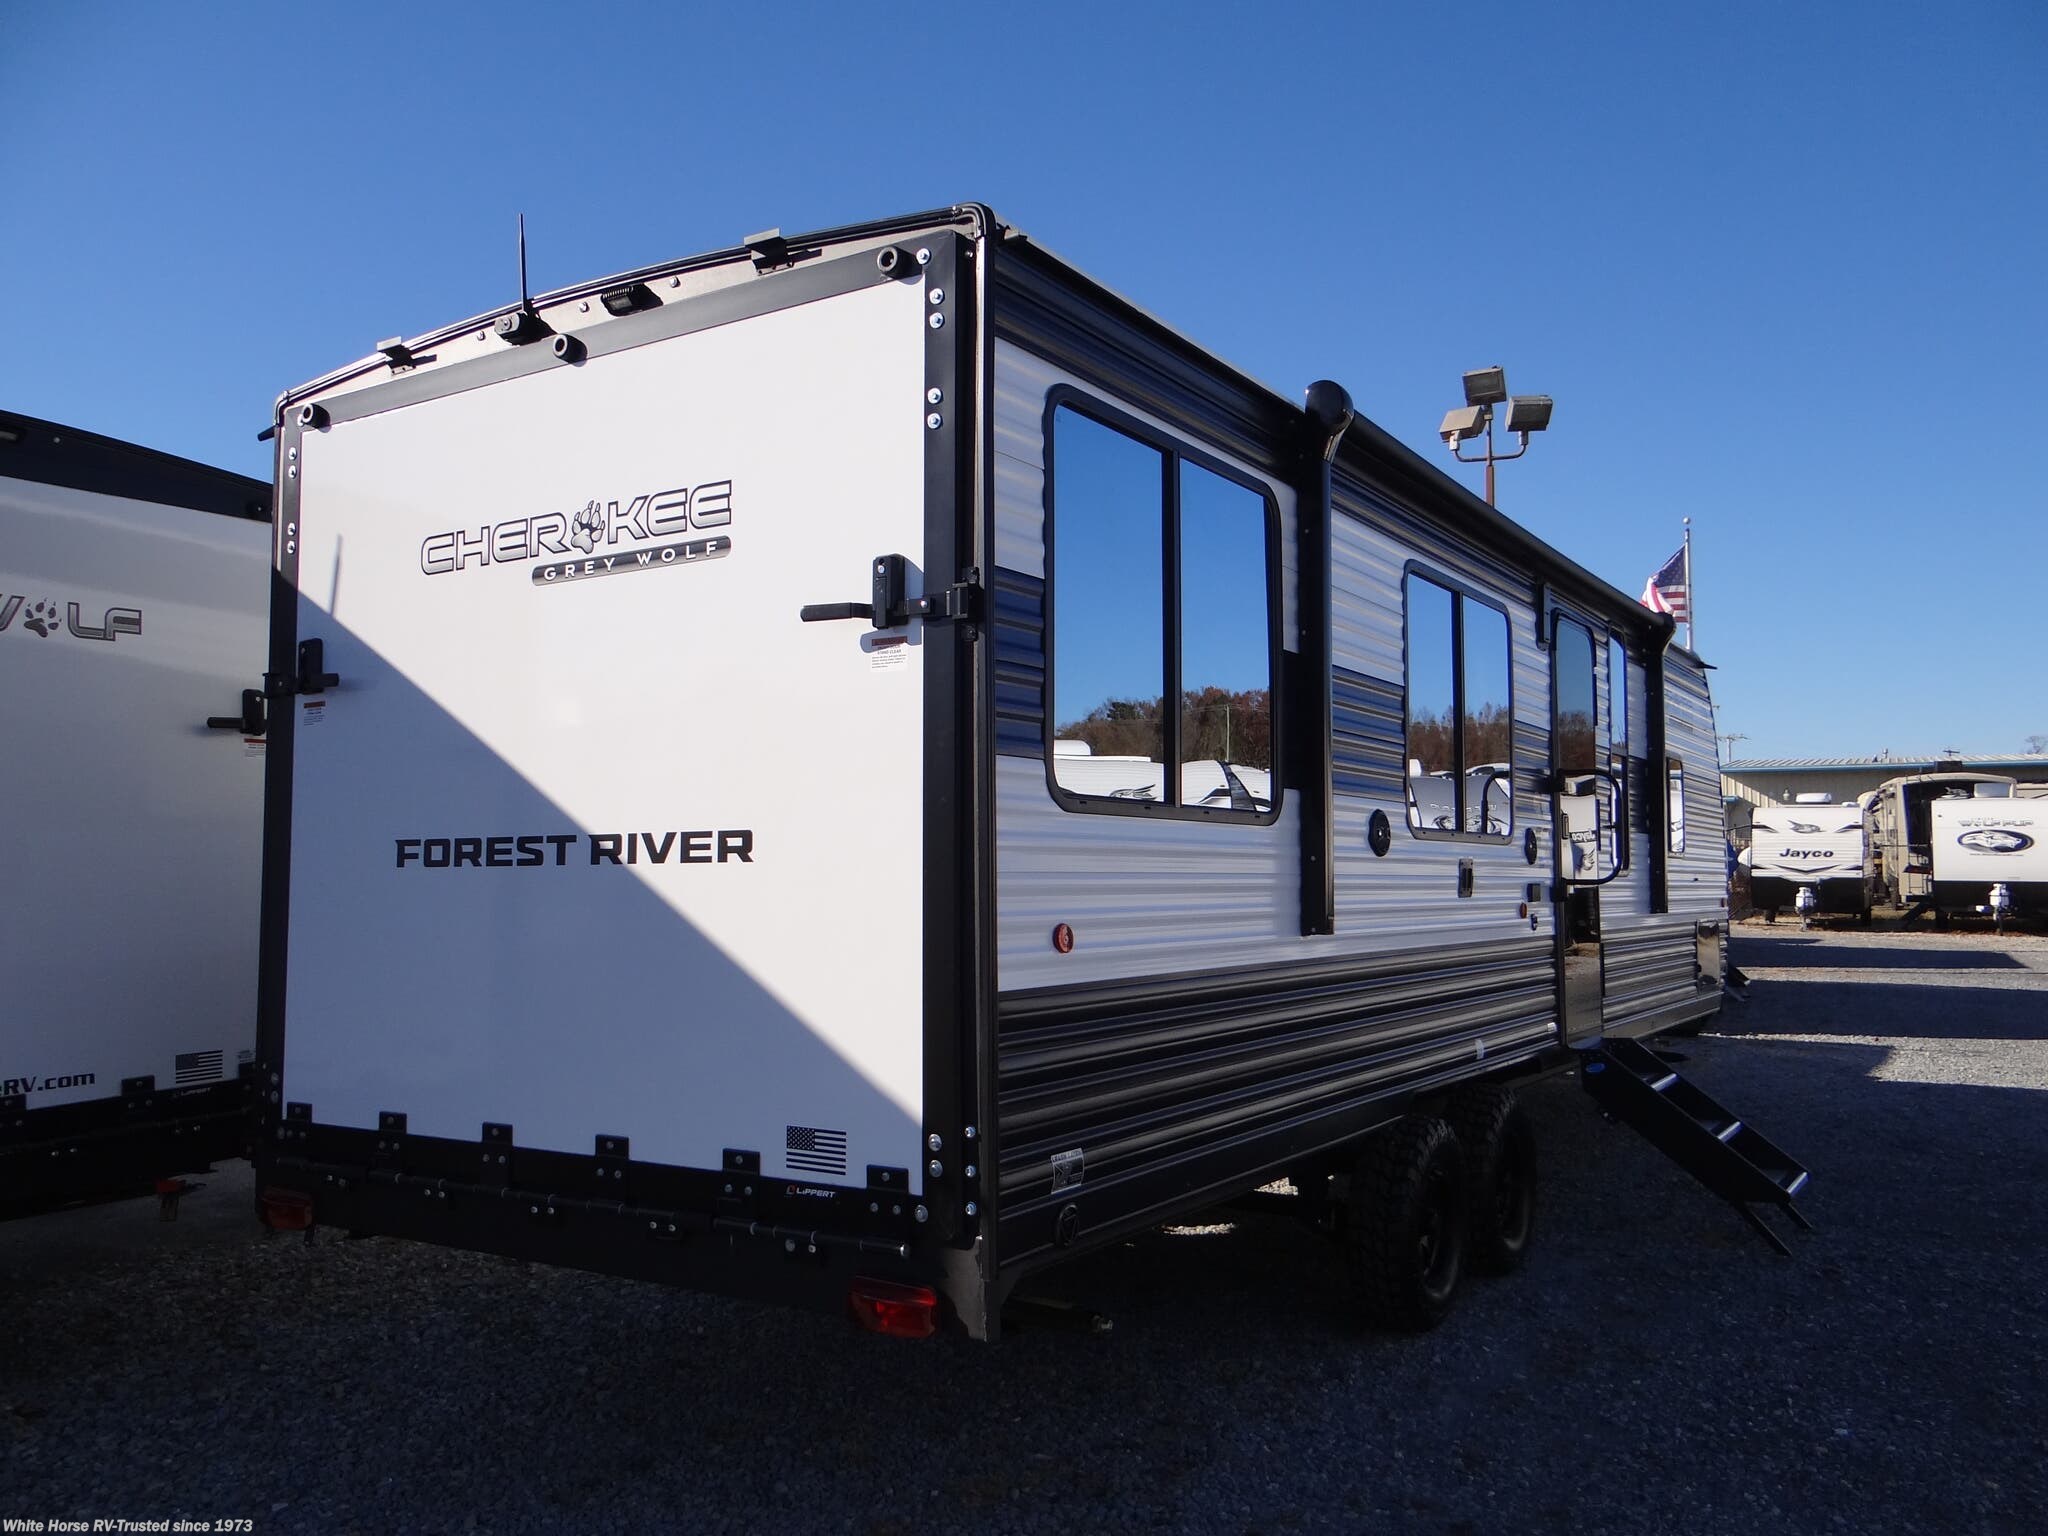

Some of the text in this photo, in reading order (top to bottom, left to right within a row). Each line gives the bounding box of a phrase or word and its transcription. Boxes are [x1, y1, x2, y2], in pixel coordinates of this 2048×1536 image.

[421, 480, 732, 575] CHEROKEE
[543, 540, 718, 581] GREY WOLF
[395, 830, 754, 868] FOREST RIVER
[1779, 848, 1834, 859] Jayco
[796, 1187, 837, 1199] LIPPERT
